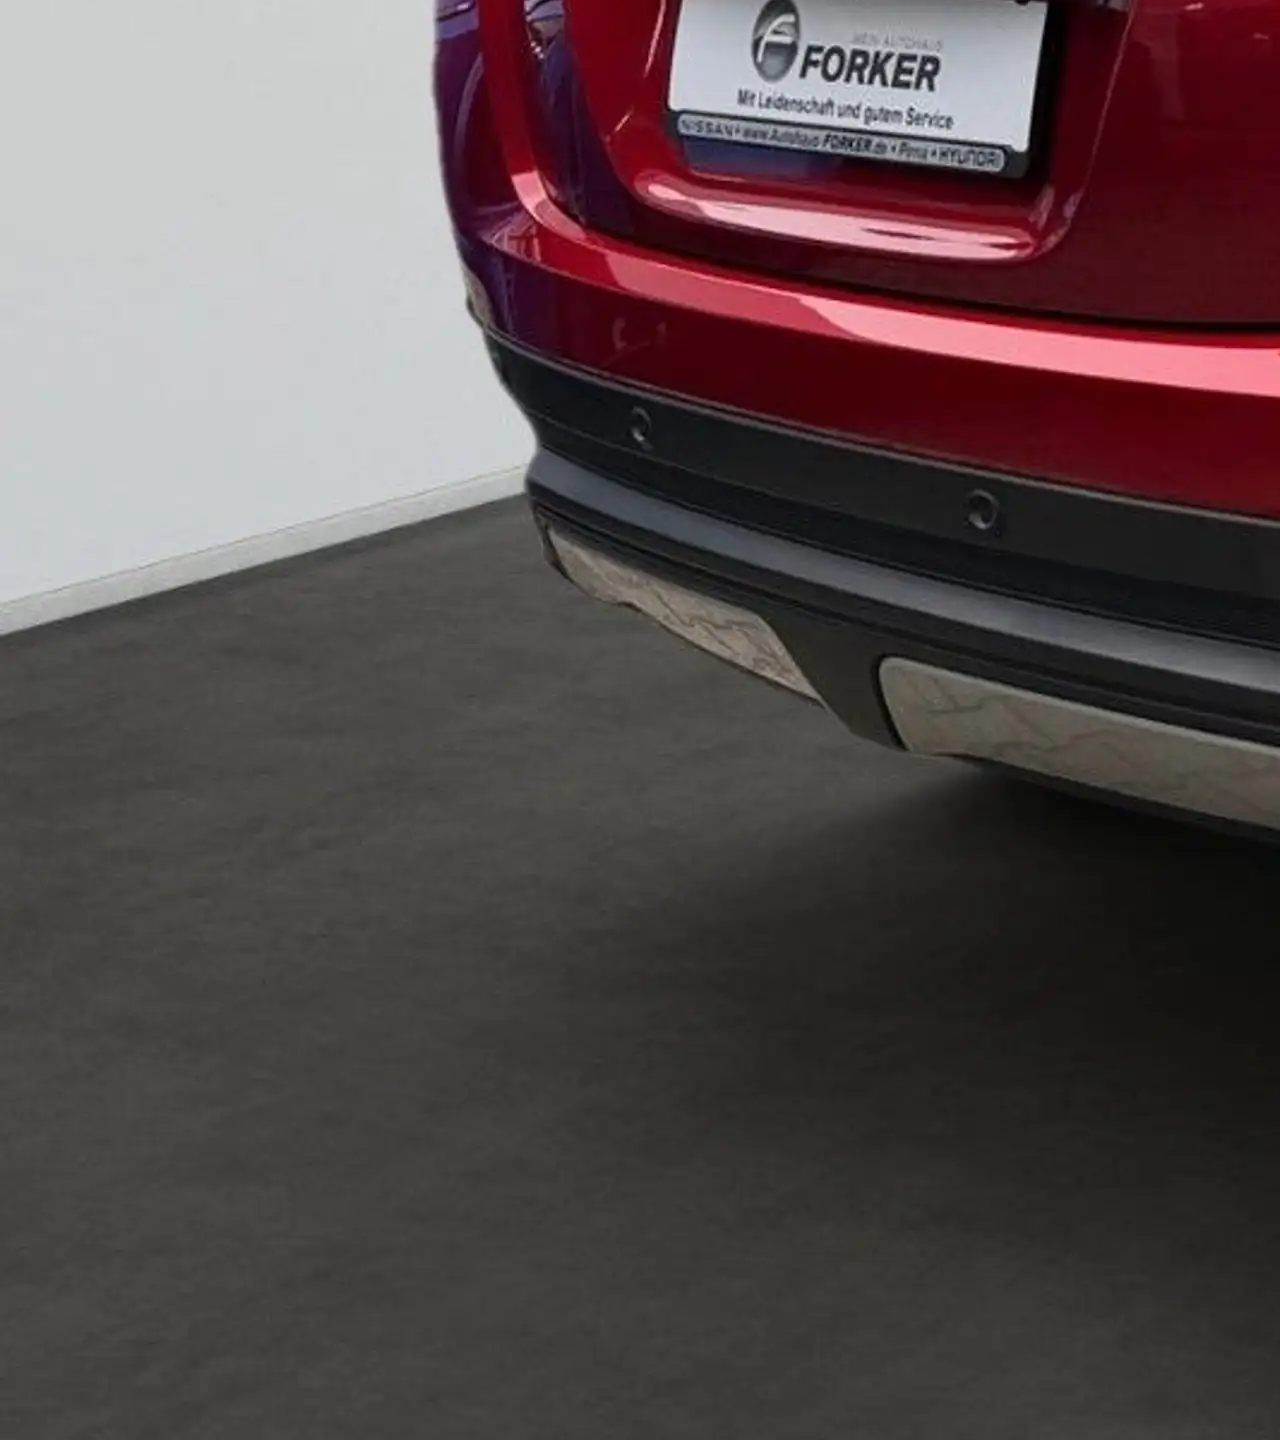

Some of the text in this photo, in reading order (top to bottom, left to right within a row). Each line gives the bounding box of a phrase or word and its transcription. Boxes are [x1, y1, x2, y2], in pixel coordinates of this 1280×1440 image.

[799, 44, 941, 92] FORKER
[737, 89, 954, 130] Mit Leidenschaft und gutem Service
